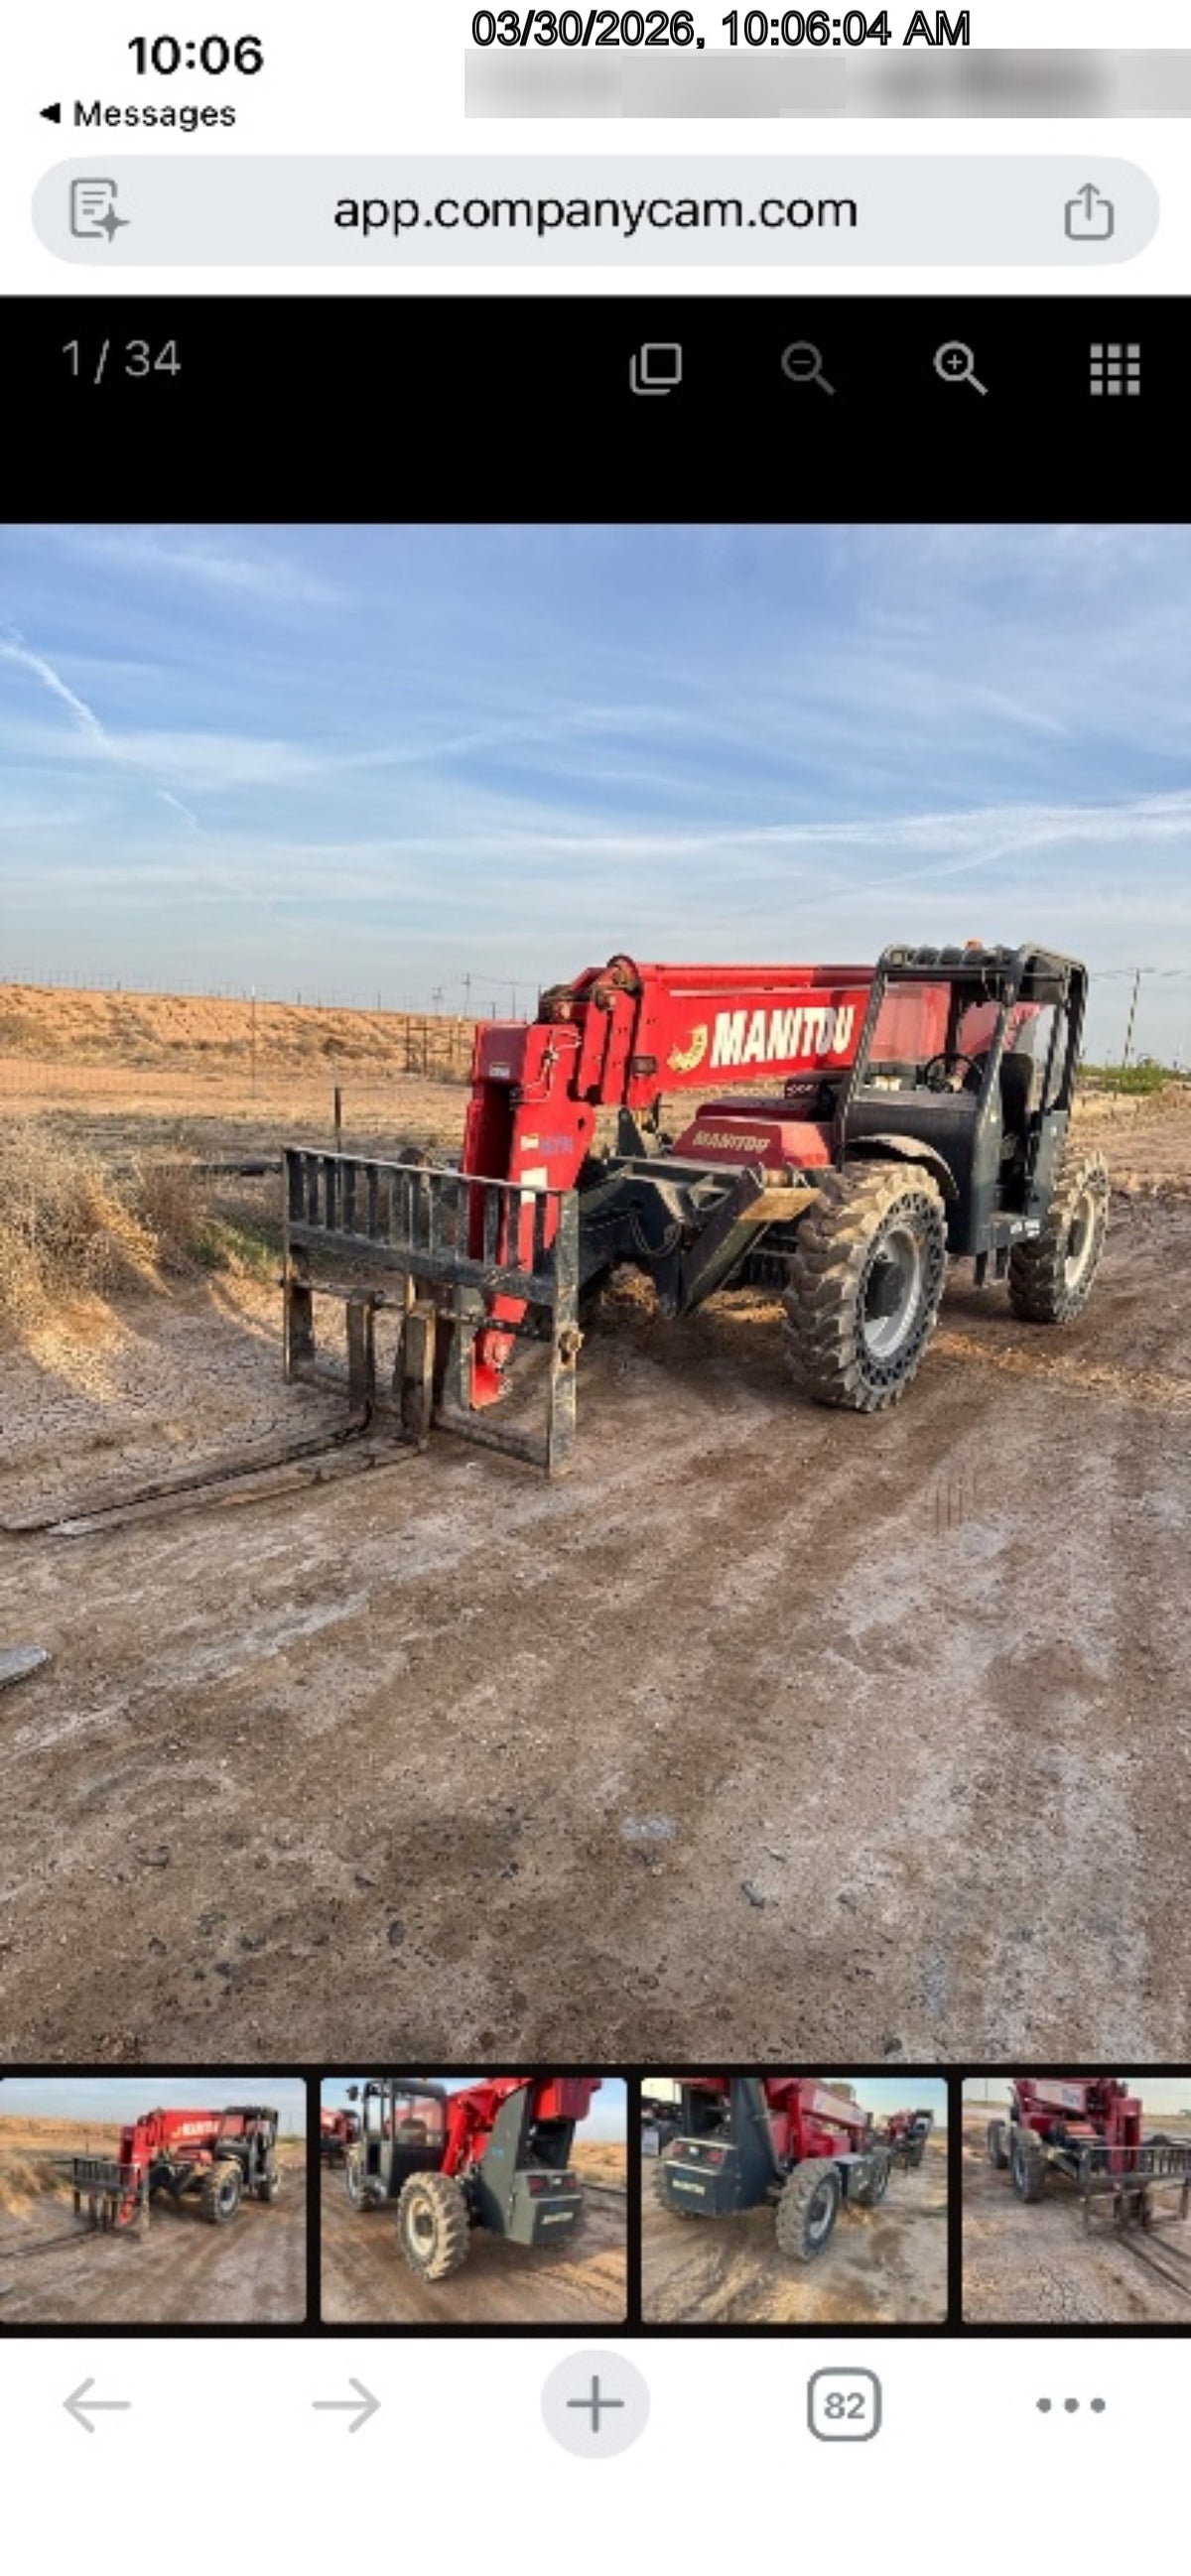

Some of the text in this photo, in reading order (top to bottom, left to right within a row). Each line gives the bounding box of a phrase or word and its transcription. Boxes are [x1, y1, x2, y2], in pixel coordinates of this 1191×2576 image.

[127, 34, 265, 76] 10:06
[72, 99, 236, 134] Messages
[333, 194, 858, 239] app.companycam.com
[62, 339, 182, 384] 1 / 34
[710, 1005, 857, 1069] MANITOU
[824, 2391, 865, 2419] 82
